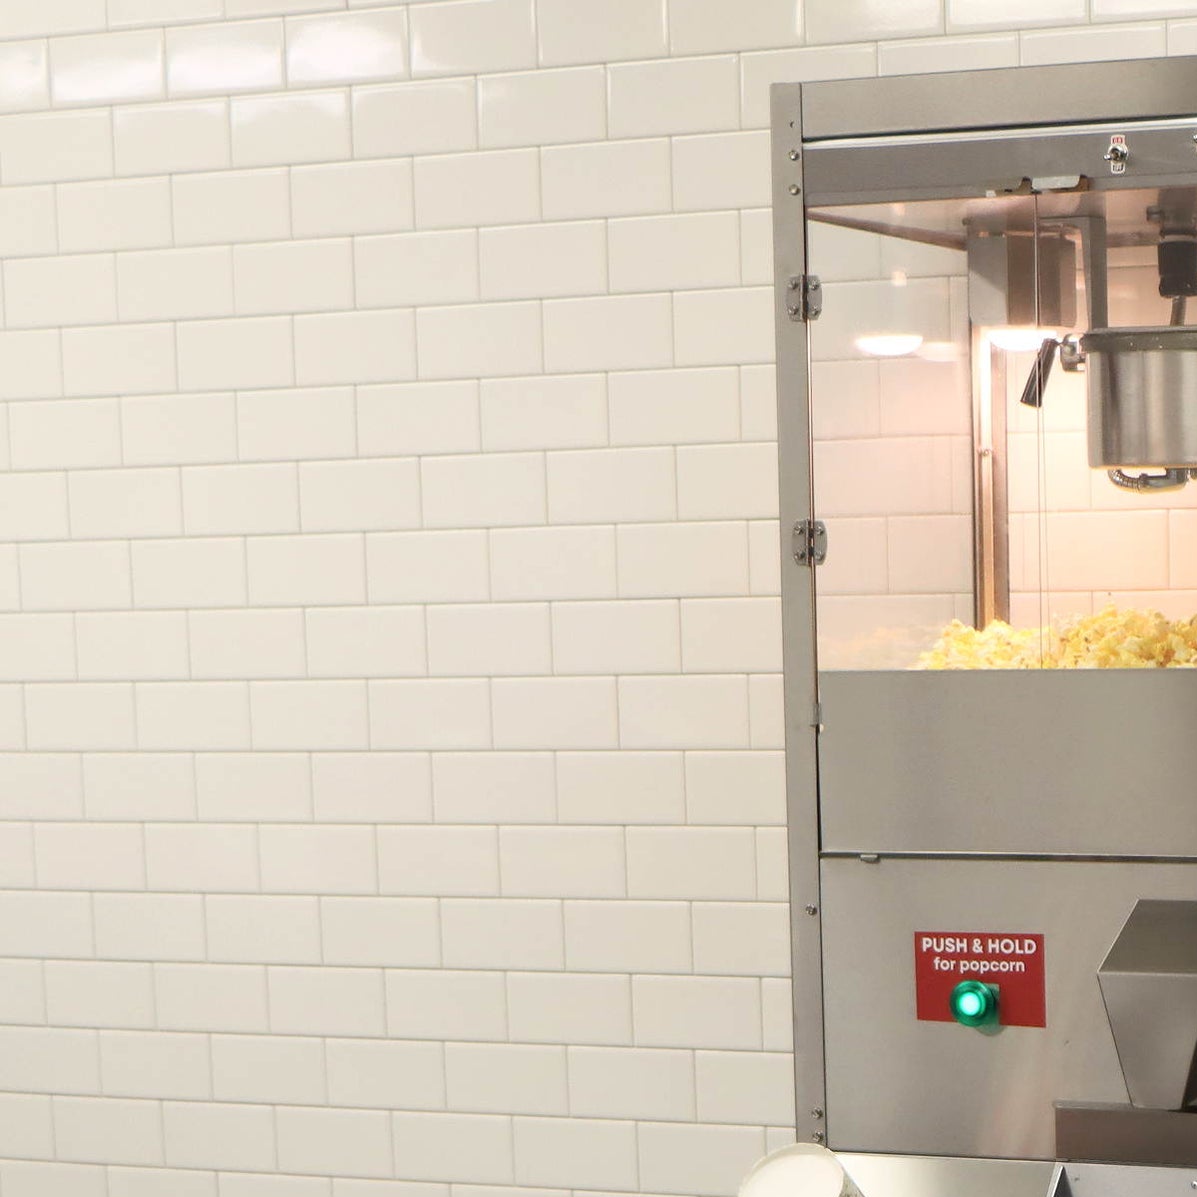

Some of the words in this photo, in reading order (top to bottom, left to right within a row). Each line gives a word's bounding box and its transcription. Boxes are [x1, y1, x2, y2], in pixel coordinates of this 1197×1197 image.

[922, 937, 968, 953] PUSH
[972, 938, 983, 954] &
[988, 938, 1037, 954] HOLD
[933, 957, 956, 970] for
[960, 959, 1025, 974] popcorn
